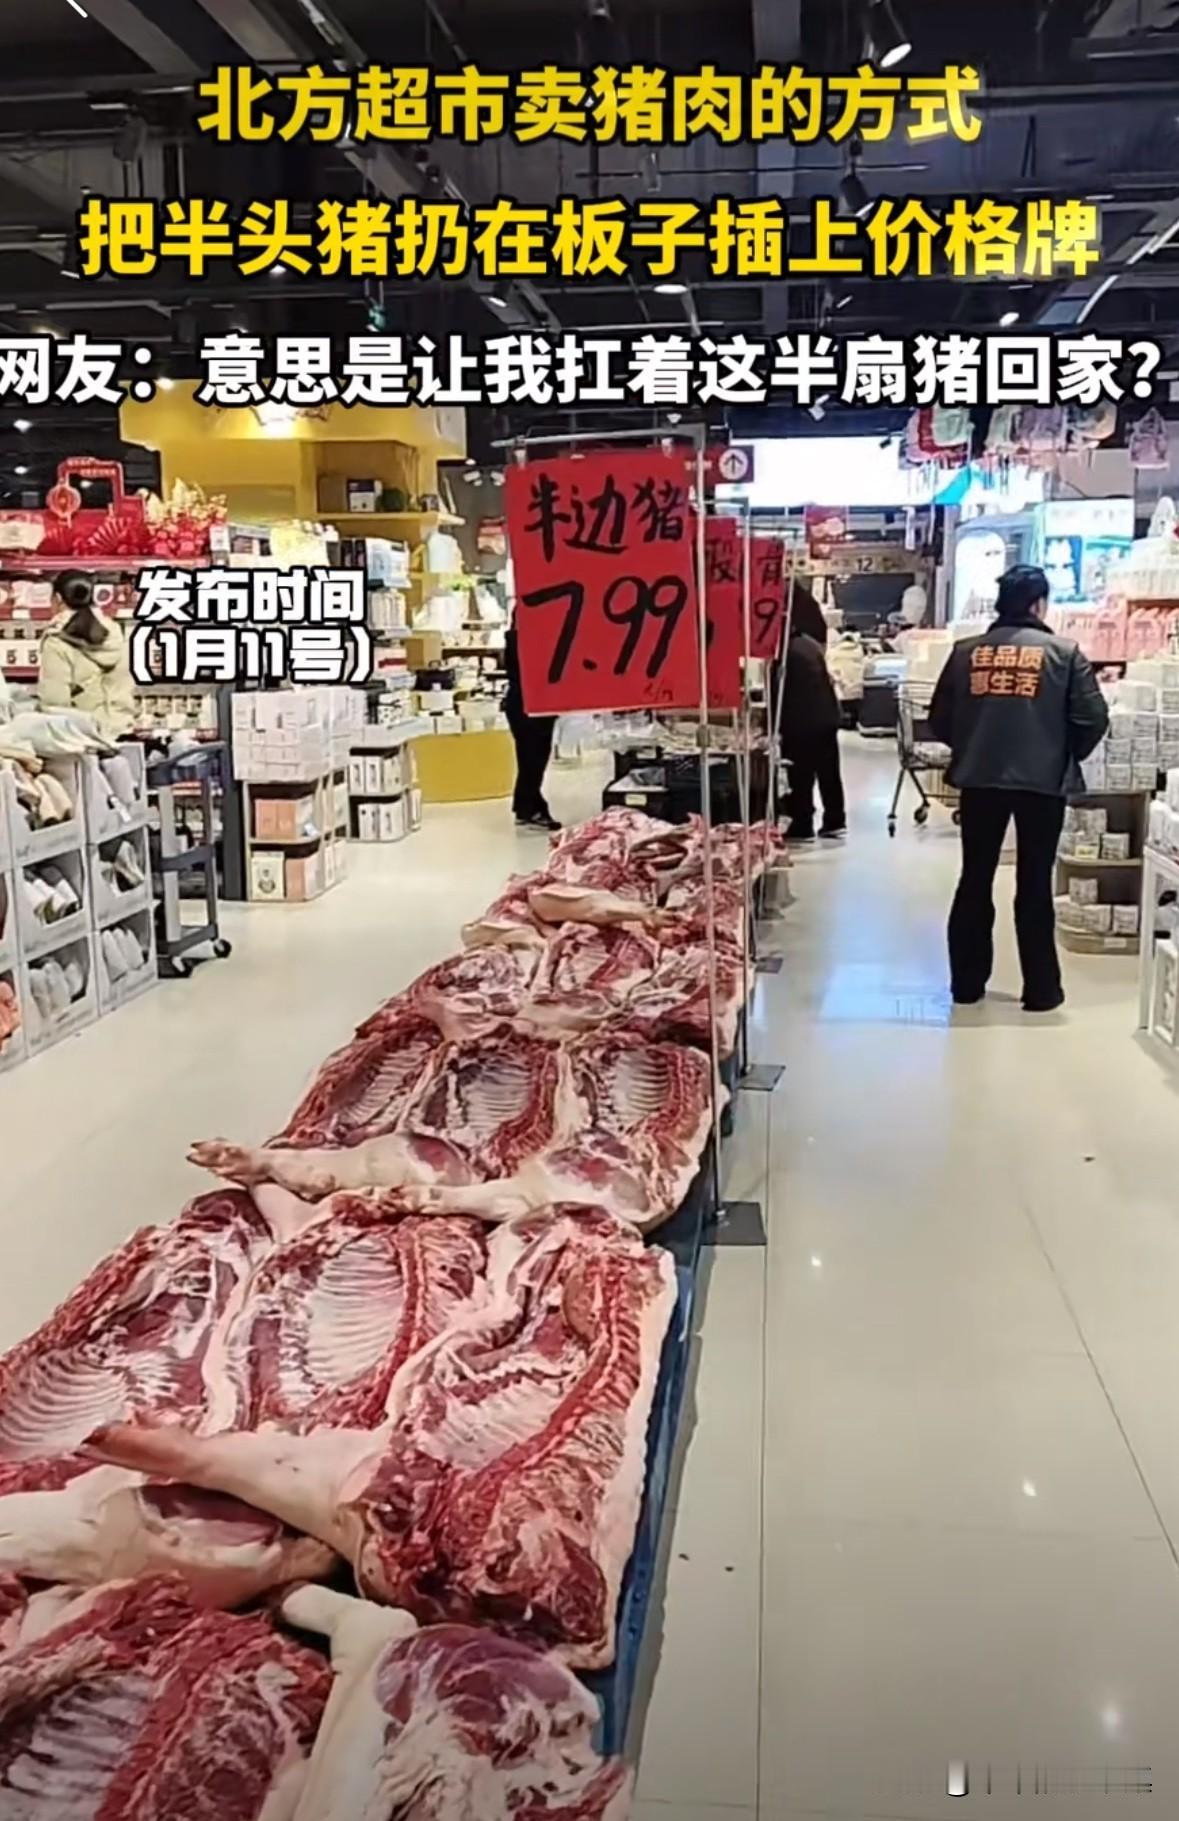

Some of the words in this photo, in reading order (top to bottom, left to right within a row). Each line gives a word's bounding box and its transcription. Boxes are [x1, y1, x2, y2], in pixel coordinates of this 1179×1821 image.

[524, 473, 684, 563] 半边猪
[856, 557, 874, 572] 12
[520, 574, 689, 684] 7.99
[970, 645, 1045, 671] 佳品质
